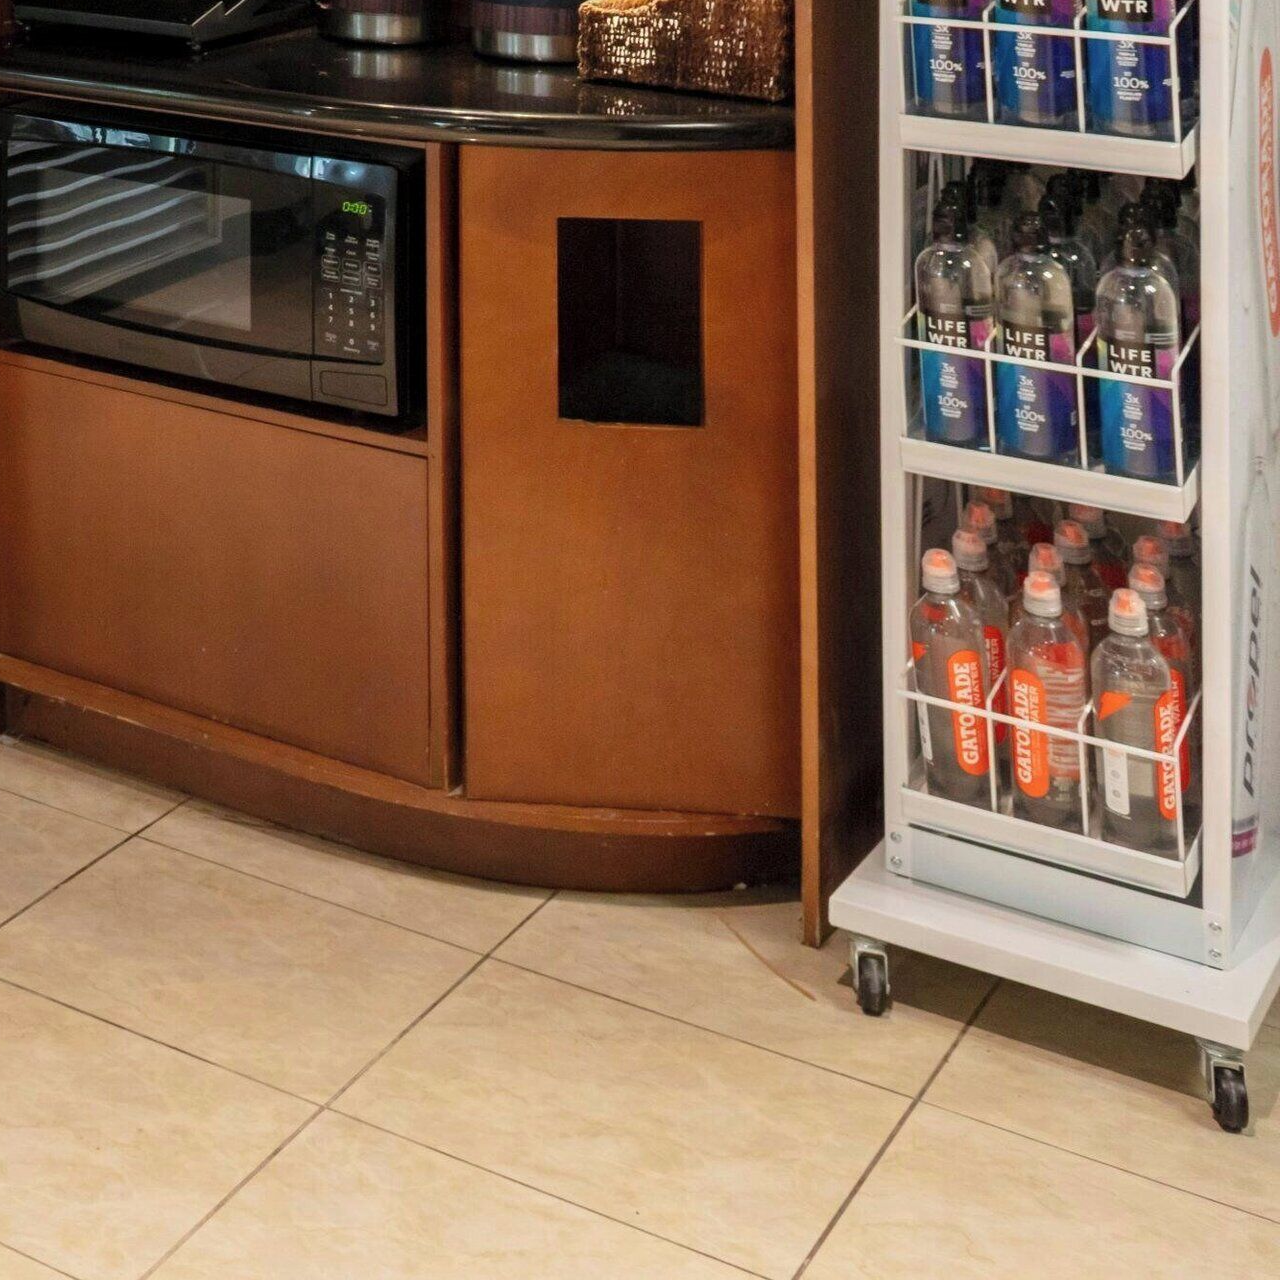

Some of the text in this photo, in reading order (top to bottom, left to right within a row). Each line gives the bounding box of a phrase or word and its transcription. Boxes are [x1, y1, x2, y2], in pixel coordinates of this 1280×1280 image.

[929, 59, 963, 71] 100%
[1013, 66, 1046, 80] 100%
[1113, 78, 1149, 90] 100%
[928, 317, 966, 333] LIFE
[928, 332, 967, 348] WTR
[1006, 328, 1045, 346] LIFE
[1006, 344, 1045, 362] WTR
[1110, 344, 1152, 362] LIFE
[1111, 361, 1152, 378] WTR
[938, 395, 968, 408] 100%
[1015, 409, 1045, 423] 100%
[1120, 427, 1153, 442] 100%
[1244, 565, 1261, 798] propel
[954, 662, 980, 764] GATOADE
[1014, 680, 1032, 784] GATOADE
